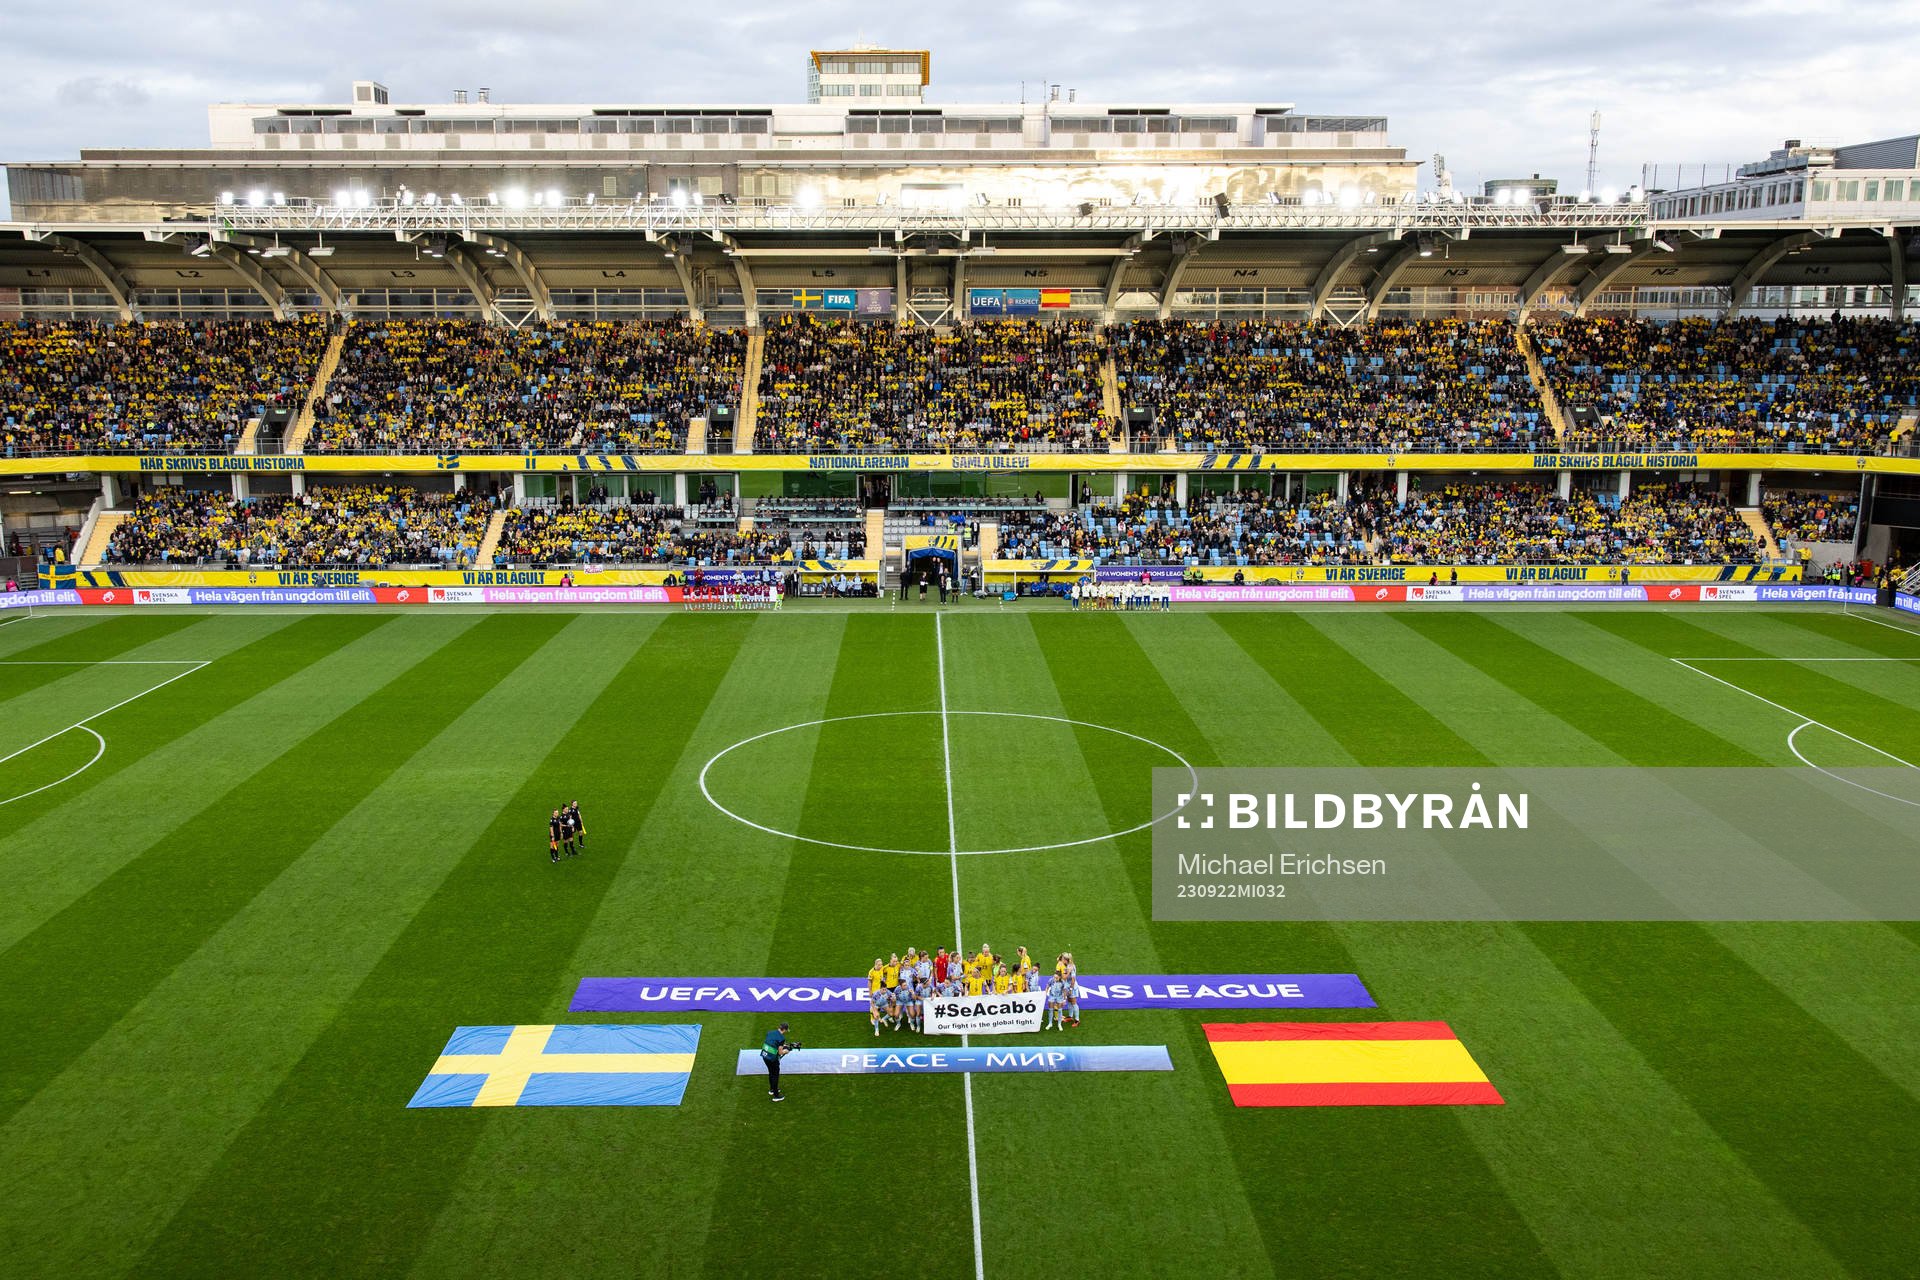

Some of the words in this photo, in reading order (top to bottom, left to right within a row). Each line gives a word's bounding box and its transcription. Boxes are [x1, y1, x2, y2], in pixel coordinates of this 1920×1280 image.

[176, 270, 206, 278] L2
[812, 269, 834, 278] L5
[1024, 270, 1048, 278] N5
[1650, 268, 1680, 276] N2
[1804, 266, 1830, 274] N1
[828, 295, 850, 304] FIFA
[972, 297, 1000, 306] UEFA
[140, 457, 164, 470] HÄR
[166, 457, 207, 470] SKRIVS
[209, 456, 251, 470] BLÅGUL
[253, 457, 305, 470] HISTORIA
[809, 456, 910, 469] NATIONALARENAN
[952, 456, 990, 468] GAMLA
[993, 456, 1029, 468] ULLEVI
[1533, 455, 1556, 468] HÄR
[1558, 455, 1600, 468] SKRIVS
[1602, 454, 1644, 468] BLÅGUL
[1646, 455, 1698, 468] HISTORIA
[278, 572, 291, 585] VI
[293, 572, 309, 585] ÄR
[462, 572, 475, 585] VI
[477, 572, 494, 585] ÄR
[496, 572, 545, 585] BLÅGULT
[1326, 568, 1338, 581] VI
[1340, 568, 1356, 581] ÄR
[1358, 568, 1406, 580] SVERIGE
[1506, 568, 1518, 580] VI
[1520, 567, 1536, 580] ÄR
[1538, 567, 1588, 580] BLÅGULT
[40, 592, 55, 602] till
[56, 592, 76, 602] elit
[196, 591, 221, 600] Hela
[223, 591, 259, 603] vägen
[262, 591, 284, 600] från
[286, 591, 334, 603] ungdom
[336, 591, 350, 600] till
[352, 591, 370, 600] elit
[490, 590, 515, 600] Hela
[517, 590, 553, 602] vägen
[555, 590, 577, 600] från
[579, 590, 628, 602] ungdom
[630, 590, 643, 600] till
[645, 590, 663, 600] elit
[1176, 589, 1202, 599] Hela
[1203, 589, 1239, 601] vägen
[1241, 589, 1263, 599] från
[1265, 589, 1314, 601] ungdom
[1316, 589, 1329, 599] till
[1331, 589, 1349, 599] elit
[1468, 588, 1493, 599] Hela
[1495, 588, 1532, 601] vägen
[1534, 588, 1557, 599] från
[1559, 588, 1607, 601] ungdom
[1608, 588, 1622, 599] till
[1624, 588, 1642, 599] elit
[1762, 588, 1788, 598] Hela
[1790, 588, 1826, 601] vägen
[1828, 588, 1852, 600] från
[640, 986, 742, 1002] UEFA
[1142, 984, 1304, 998] LEAGUE
[934, 1000, 1036, 1018] #SeAcabó
[992, 1020, 1014, 1028] global
[841, 1054, 949, 1068] PEACE
[986, 1052, 1066, 1067] МИР
